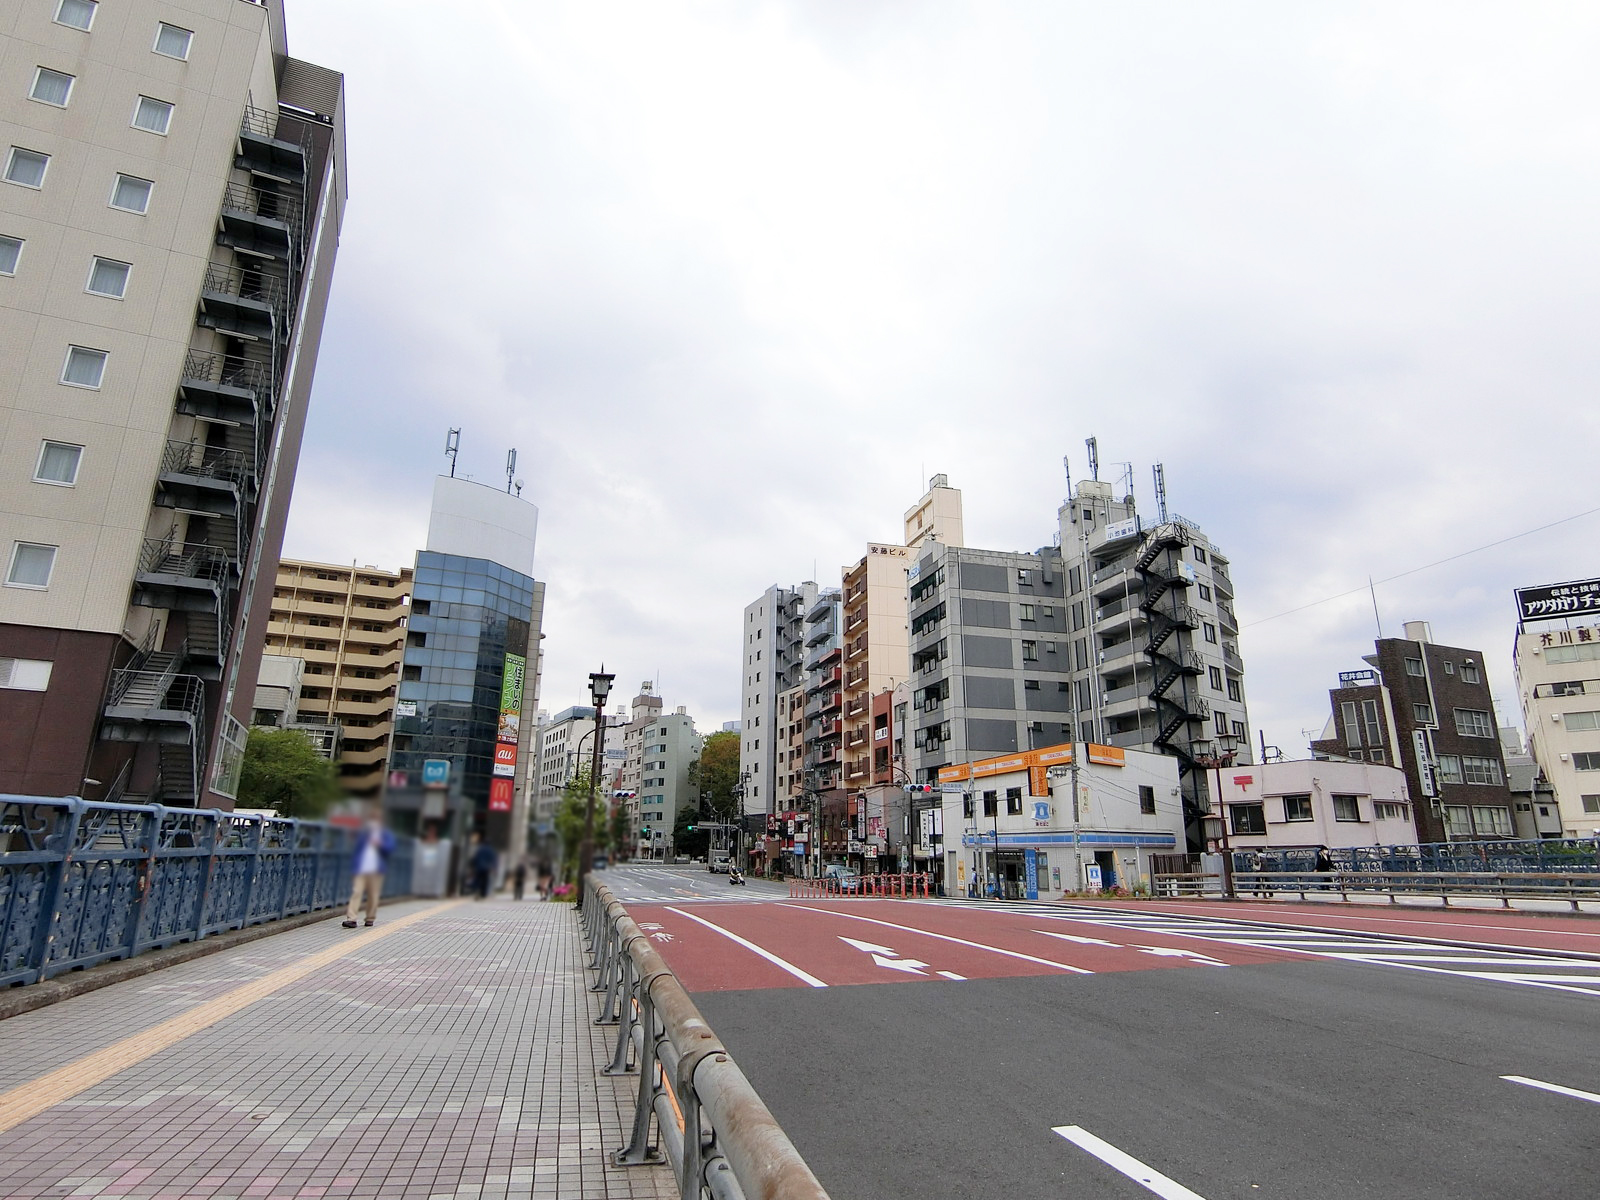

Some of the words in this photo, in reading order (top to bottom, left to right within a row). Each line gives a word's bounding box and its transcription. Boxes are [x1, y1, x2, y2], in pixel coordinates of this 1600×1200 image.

[870, 546, 906, 556] 安藤ビル
[498, 749, 513, 760] au
[1029, 856, 1037, 893] LAWSON
